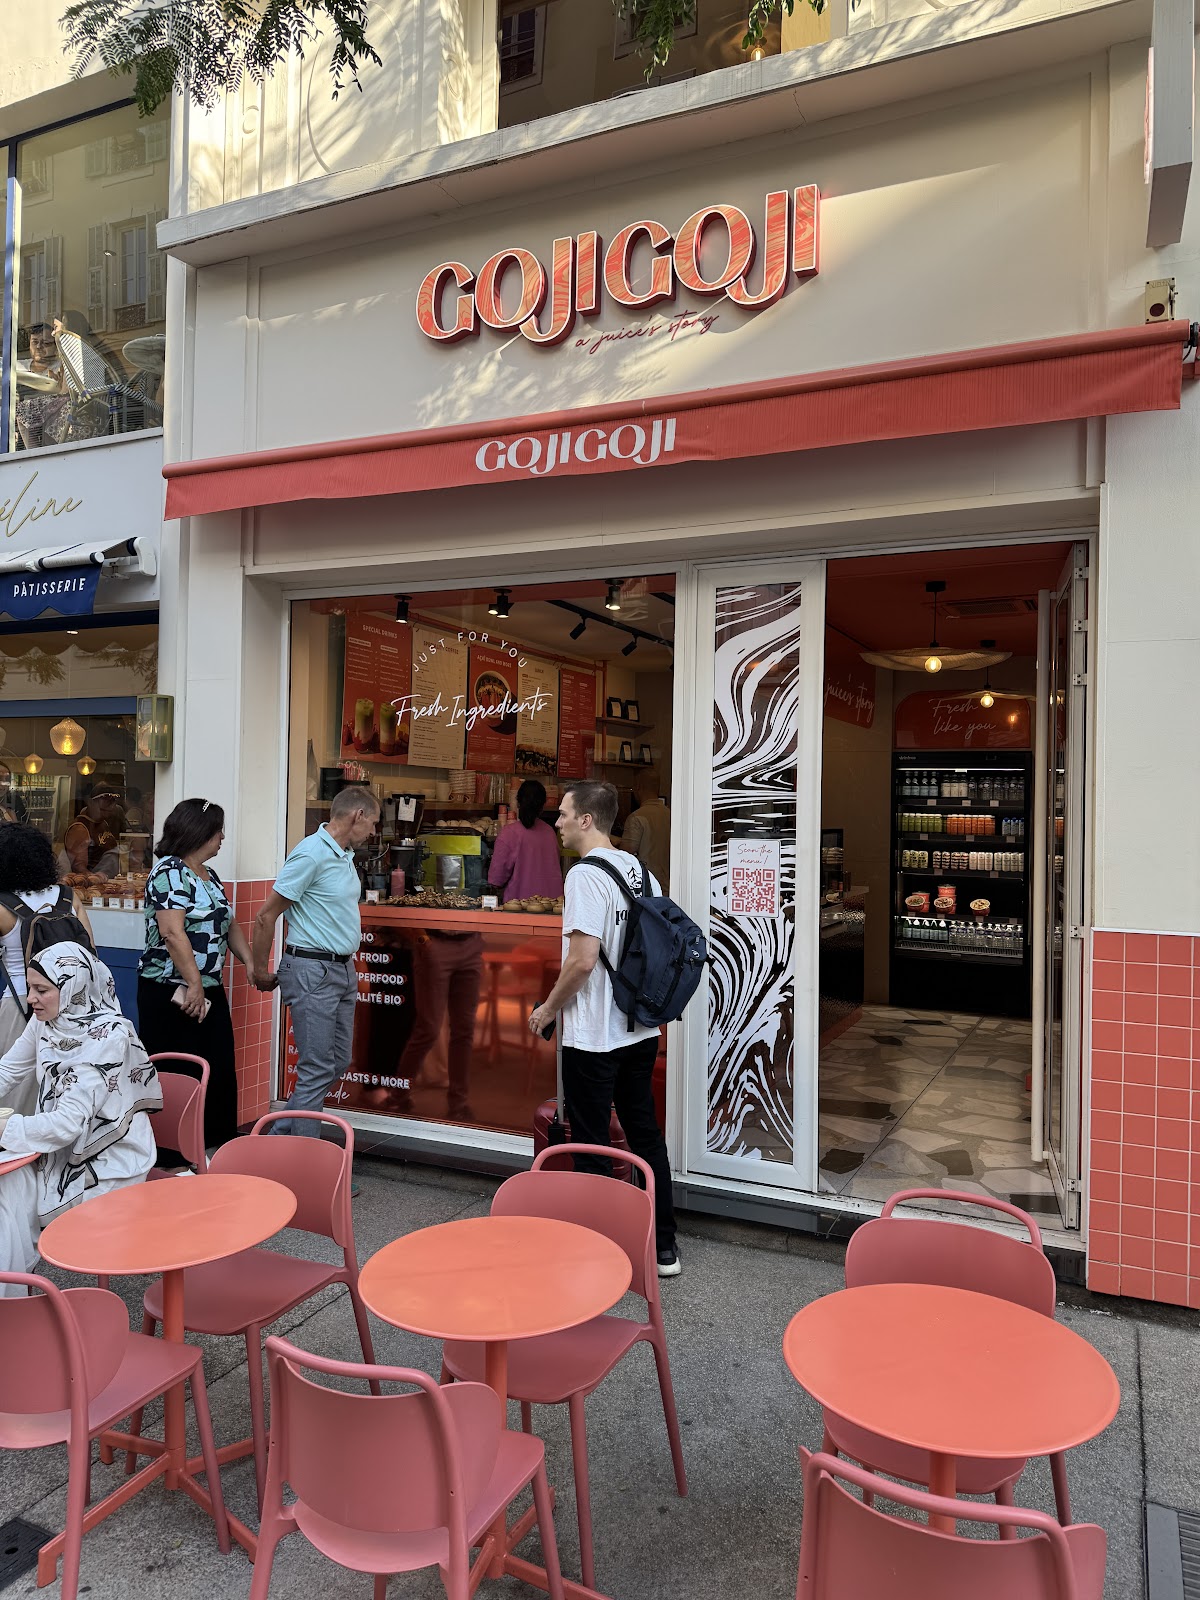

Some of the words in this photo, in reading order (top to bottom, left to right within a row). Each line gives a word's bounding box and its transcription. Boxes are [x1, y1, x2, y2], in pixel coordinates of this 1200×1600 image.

[416, 184, 820, 346] GOJIGOJI
[575, 336, 590, 348] a
[590, 315, 661, 354] juice's
[667, 310, 720, 341] story
[475, 418, 676, 474] GOJIGOJI
[13, 577, 86, 598] PÂTISSERIE
[413, 638, 446, 672] JUST
[457, 631, 489, 643] FOR
[500, 640, 528, 667] YOU
[391, 692, 448, 726] Fresh
[446, 687, 553, 731] Ingredients
[855, 682, 875, 723] story
[927, 698, 979, 718] Fresh
[933, 715, 963, 735] like
[964, 723, 997, 740] you
[737, 844, 759, 855] Scan
[758, 844, 773, 857] the
[360, 952, 390, 964] FROID
[356, 972, 405, 985] PERFOOD
[356, 991, 383, 1004] ALITÉ
[384, 994, 402, 1006] BIO
[371, 1075, 379, 1085] &
[380, 1075, 410, 1089] MORE
